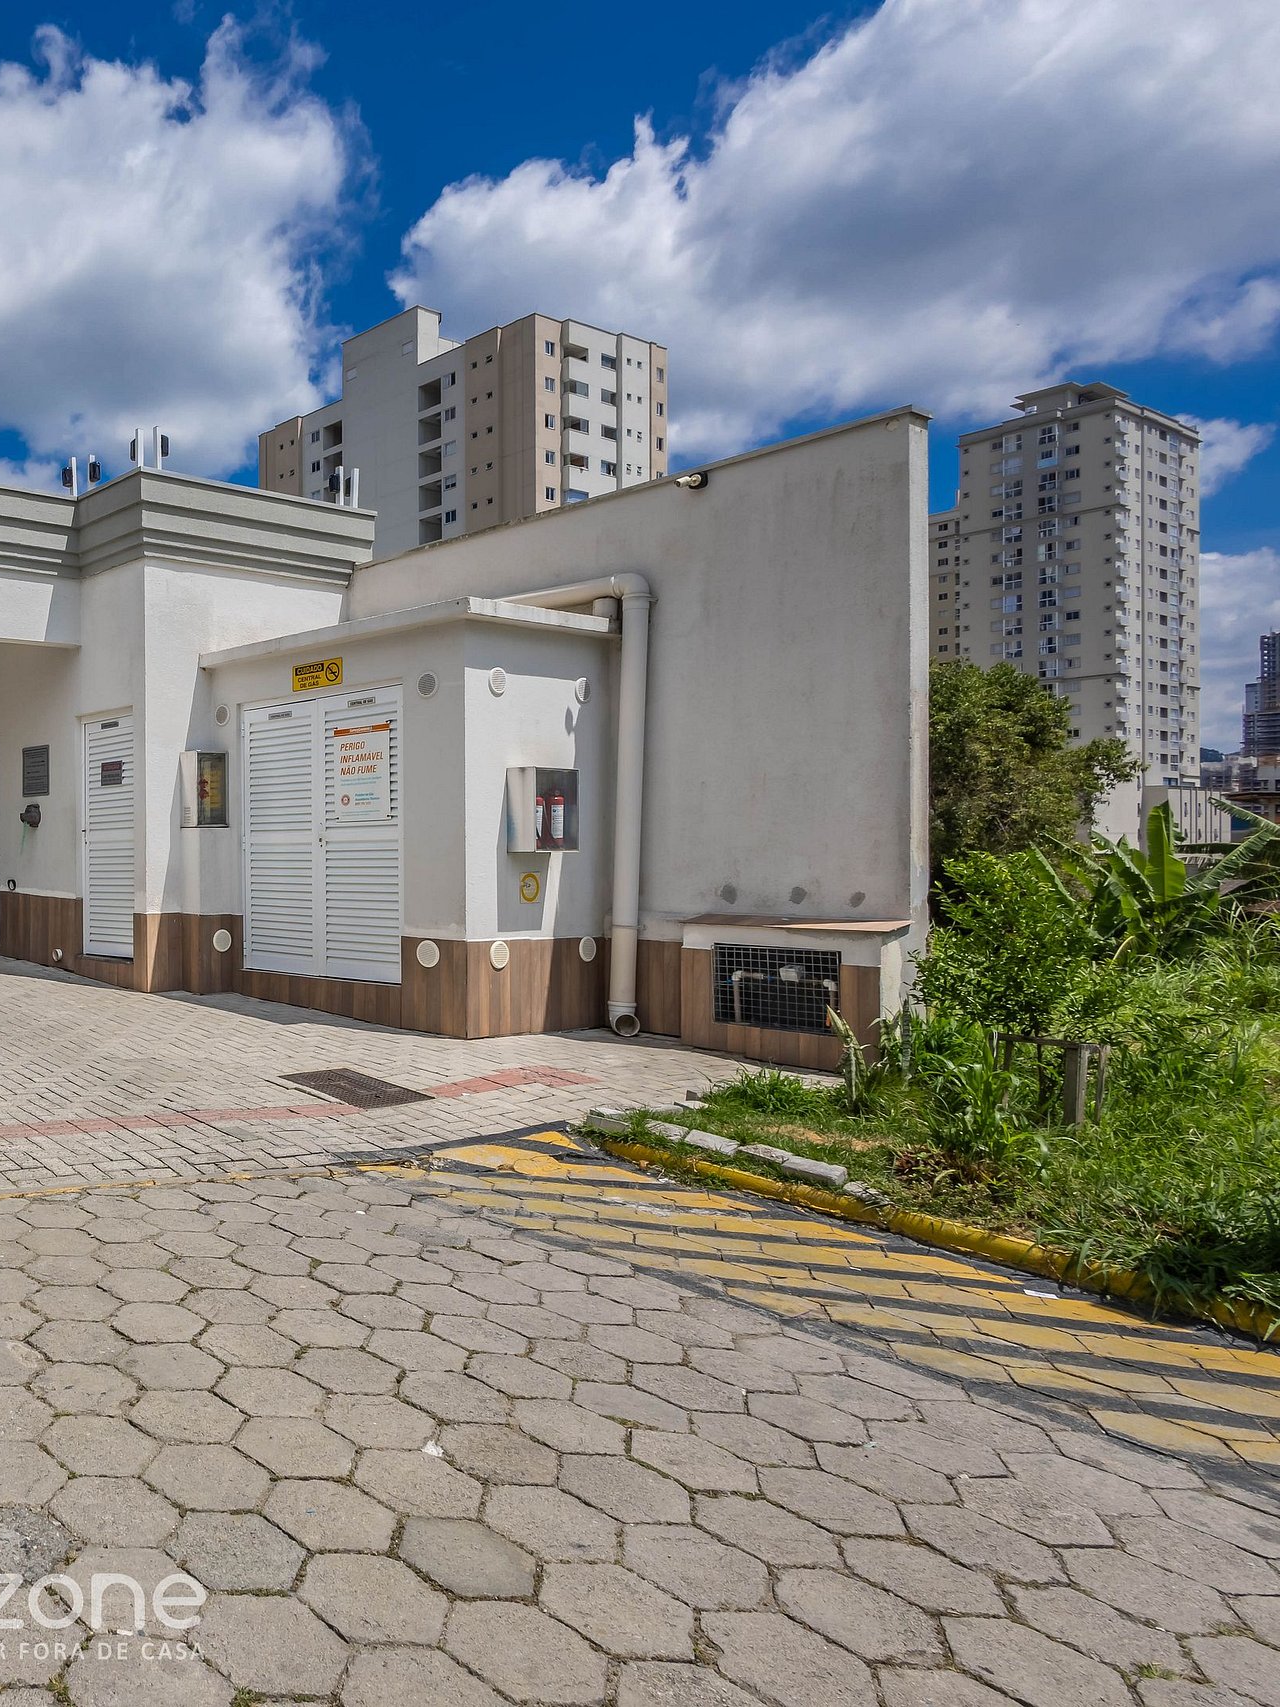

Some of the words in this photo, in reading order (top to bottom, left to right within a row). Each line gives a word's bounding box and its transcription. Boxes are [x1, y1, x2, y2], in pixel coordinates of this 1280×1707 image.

[297, 665, 322, 674] CUIDADO
[298, 674, 322, 682] CENTRAL
[340, 741, 365, 751] PERIGO
[340, 750, 383, 763] INFLAMÁVEL
[340, 765, 356, 776] NÃO
[357, 765, 377, 774] FUME
